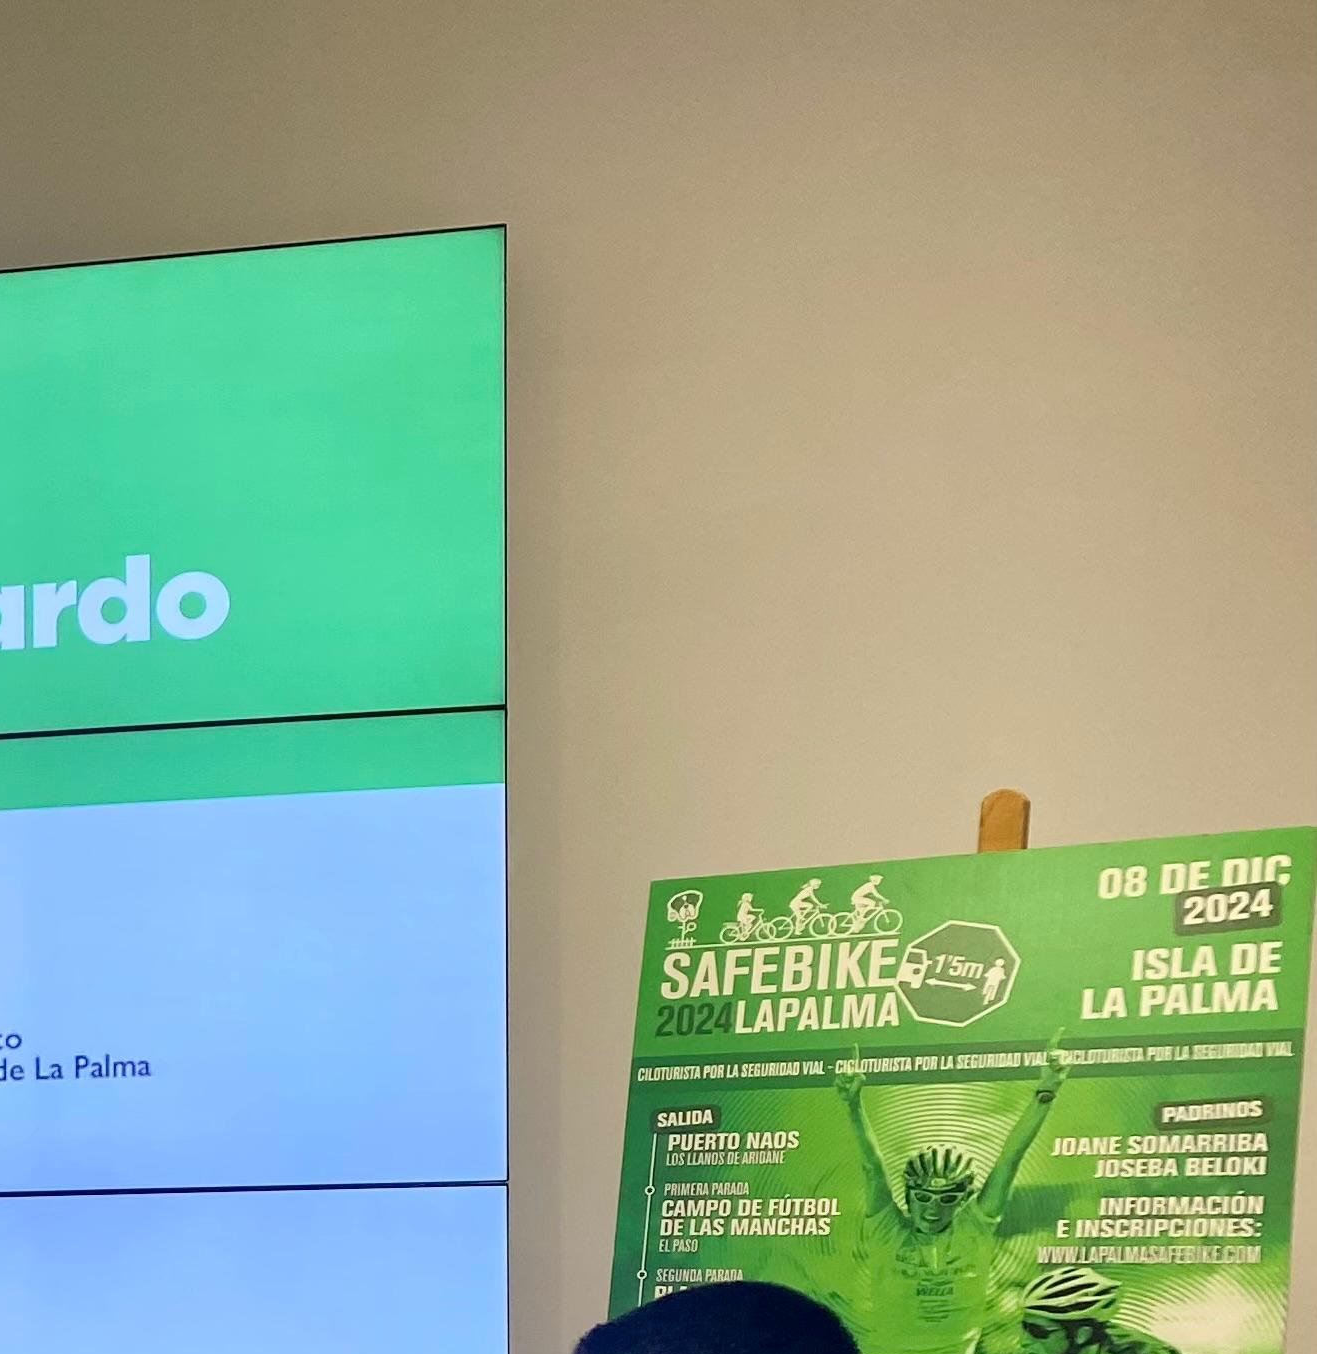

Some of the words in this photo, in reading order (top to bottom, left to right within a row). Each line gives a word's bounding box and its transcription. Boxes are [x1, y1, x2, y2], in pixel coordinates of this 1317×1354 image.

[1098, 865, 1148, 899] 08
[1159, 860, 1211, 894] DE
[1222, 854, 1292, 887] DIC
[1183, 888, 1274, 926] 2024
[661, 938, 899, 1000] SAFEBIKE
[1131, 945, 1218, 981] ISLA
[1230, 941, 1283, 975] DE
[1080, 987, 1127, 1020] LA
[1139, 979, 1279, 1017] PALMA
[35, 1056, 64, 1080] La
[74, 1054, 151, 1079] Palma
[703, 1065, 724, 1079] POR
[726, 1064, 739, 1078] LA
[741, 1061, 800, 1077] SEGURIDAD
[802, 1060, 825, 1075] VIAL
[915, 1056, 938, 1071] POR
[940, 1055, 954, 1070] LA
[957, 1052, 1020, 1069] SEGURIDAD
[1023, 1051, 1049, 1066] VIAL
[1175, 1046, 1191, 1060] LA
[657, 1109, 714, 1128] SALIDA
[1161, 1100, 1264, 1123] PADRINOS
[668, 1132, 741, 1151] PUERTO
[746, 1130, 800, 1150] NAOS
[1051, 1135, 1123, 1156] JOANE
[1127, 1133, 1269, 1155] SOMARRIBA
[666, 1152, 685, 1167] LOS
[687, 1152, 725, 1167] LLANOS
[726, 1151, 740, 1166] DE
[741, 1150, 785, 1165] ARIDANE
[1094, 1158, 1179, 1179] JOSEBA
[1185, 1156, 1267, 1177] BELOKI
[664, 1183, 709, 1196] PRIMERA
[711, 1182, 750, 1196] PARADA
[662, 1199, 732, 1218] CAMPO
[737, 1198, 762, 1217] DE
[768, 1193, 842, 1217] FÚTBOL
[1099, 1191, 1265, 1216] INFORMACIÓN
[660, 1219, 684, 1236] DE
[689, 1218, 725, 1236] LAS
[730, 1217, 832, 1236] MANCHAS
[1056, 1219, 1071, 1239] E
[1075, 1218, 1262, 1239] INSCRIPCIONES:
[659, 1239, 670, 1253] EL
[672, 1239, 699, 1253] PASO
[656, 1268, 703, 1283] SEGUNDA
[705, 1268, 744, 1282] PARADA
